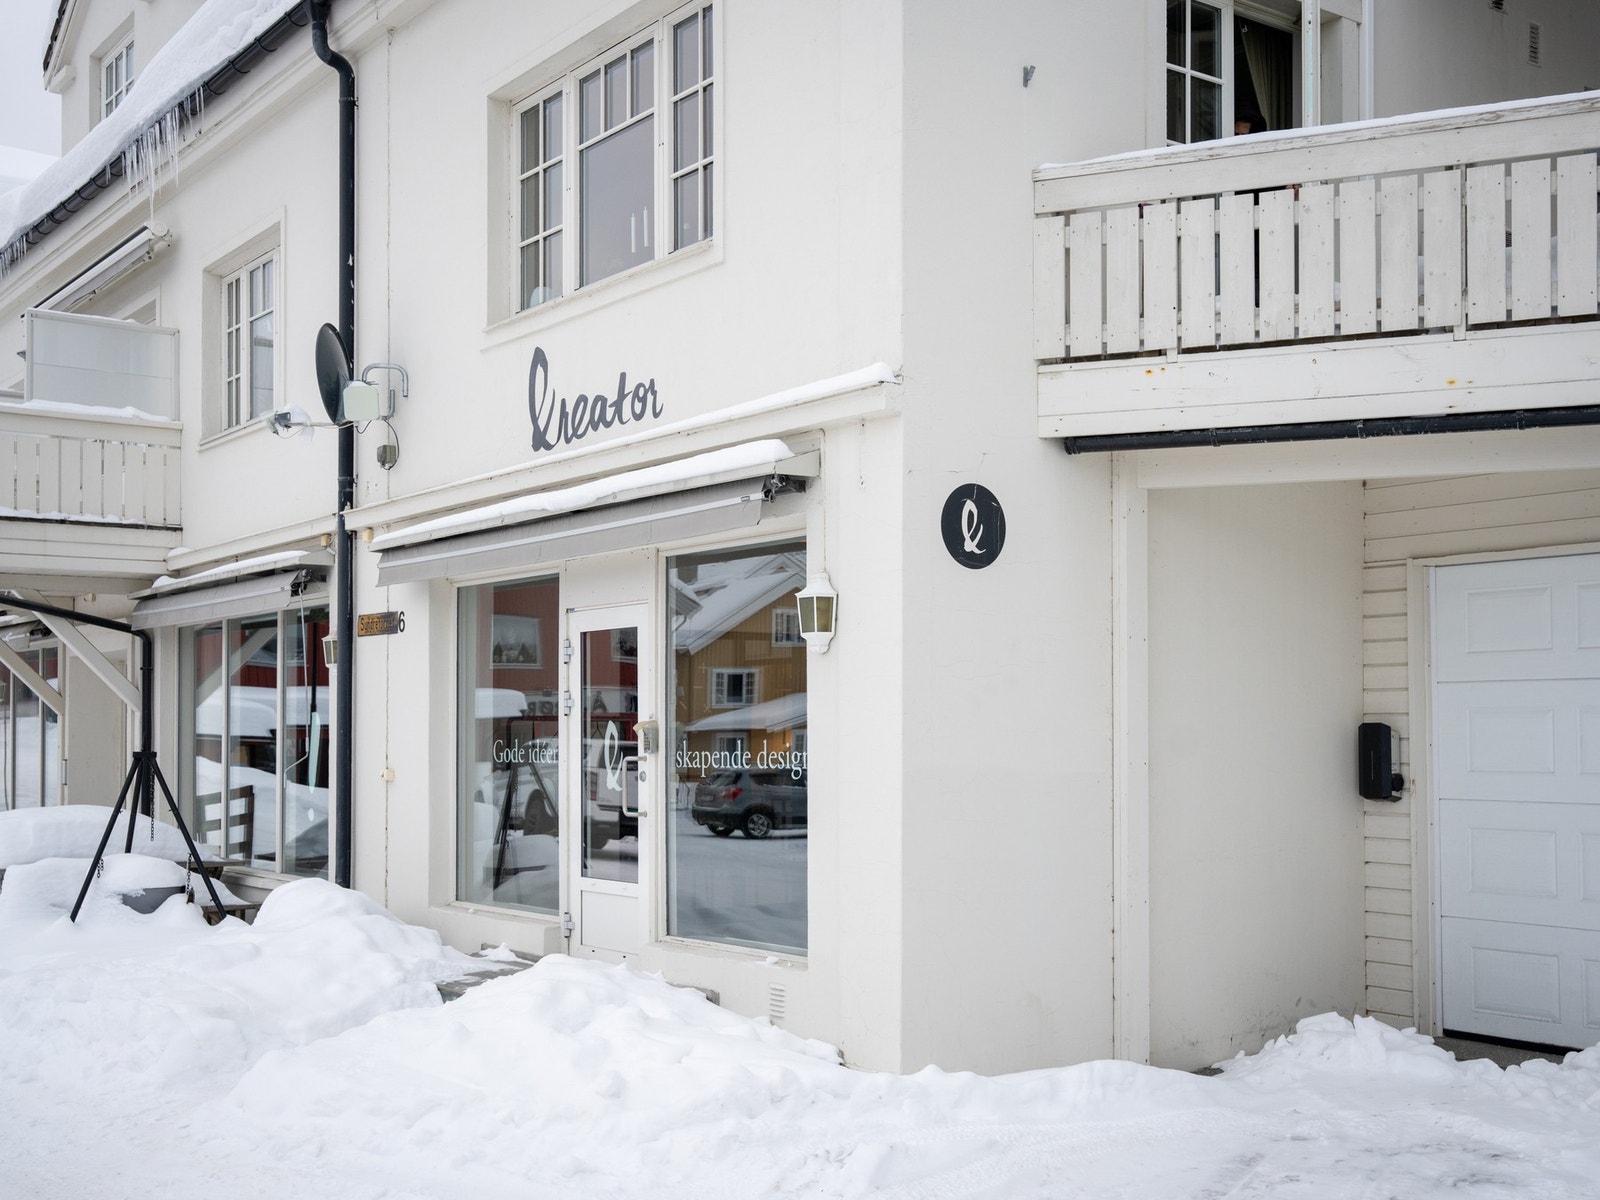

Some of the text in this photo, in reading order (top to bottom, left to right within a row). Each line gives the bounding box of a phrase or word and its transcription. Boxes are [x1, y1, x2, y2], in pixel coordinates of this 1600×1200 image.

[398, 610, 406, 633] 6
[493, 738, 559, 764] Gode idéer
[676, 739, 752, 778] skapende
